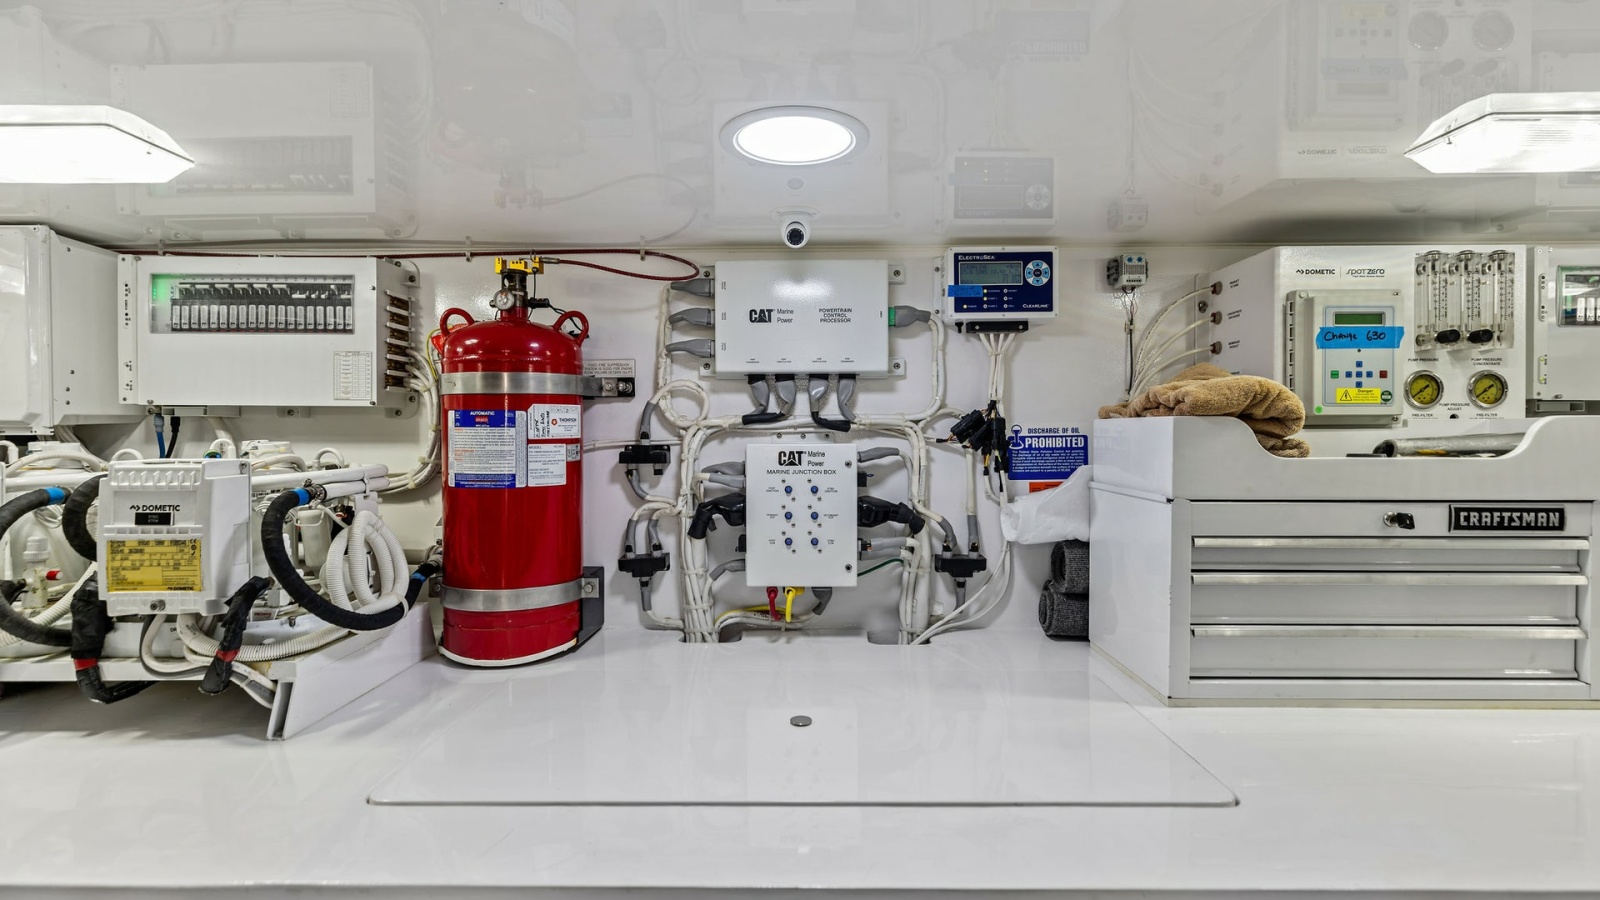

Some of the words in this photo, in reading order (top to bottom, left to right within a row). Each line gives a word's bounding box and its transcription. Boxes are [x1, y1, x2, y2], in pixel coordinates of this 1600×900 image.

[750, 309, 773, 323] CAT
[1366, 330, 1386, 341] 630
[1025, 437, 1084, 448] PROHIBITED
[778, 451, 803, 466] CAT
[1460, 512, 1559, 526] CRAFTSMAN
